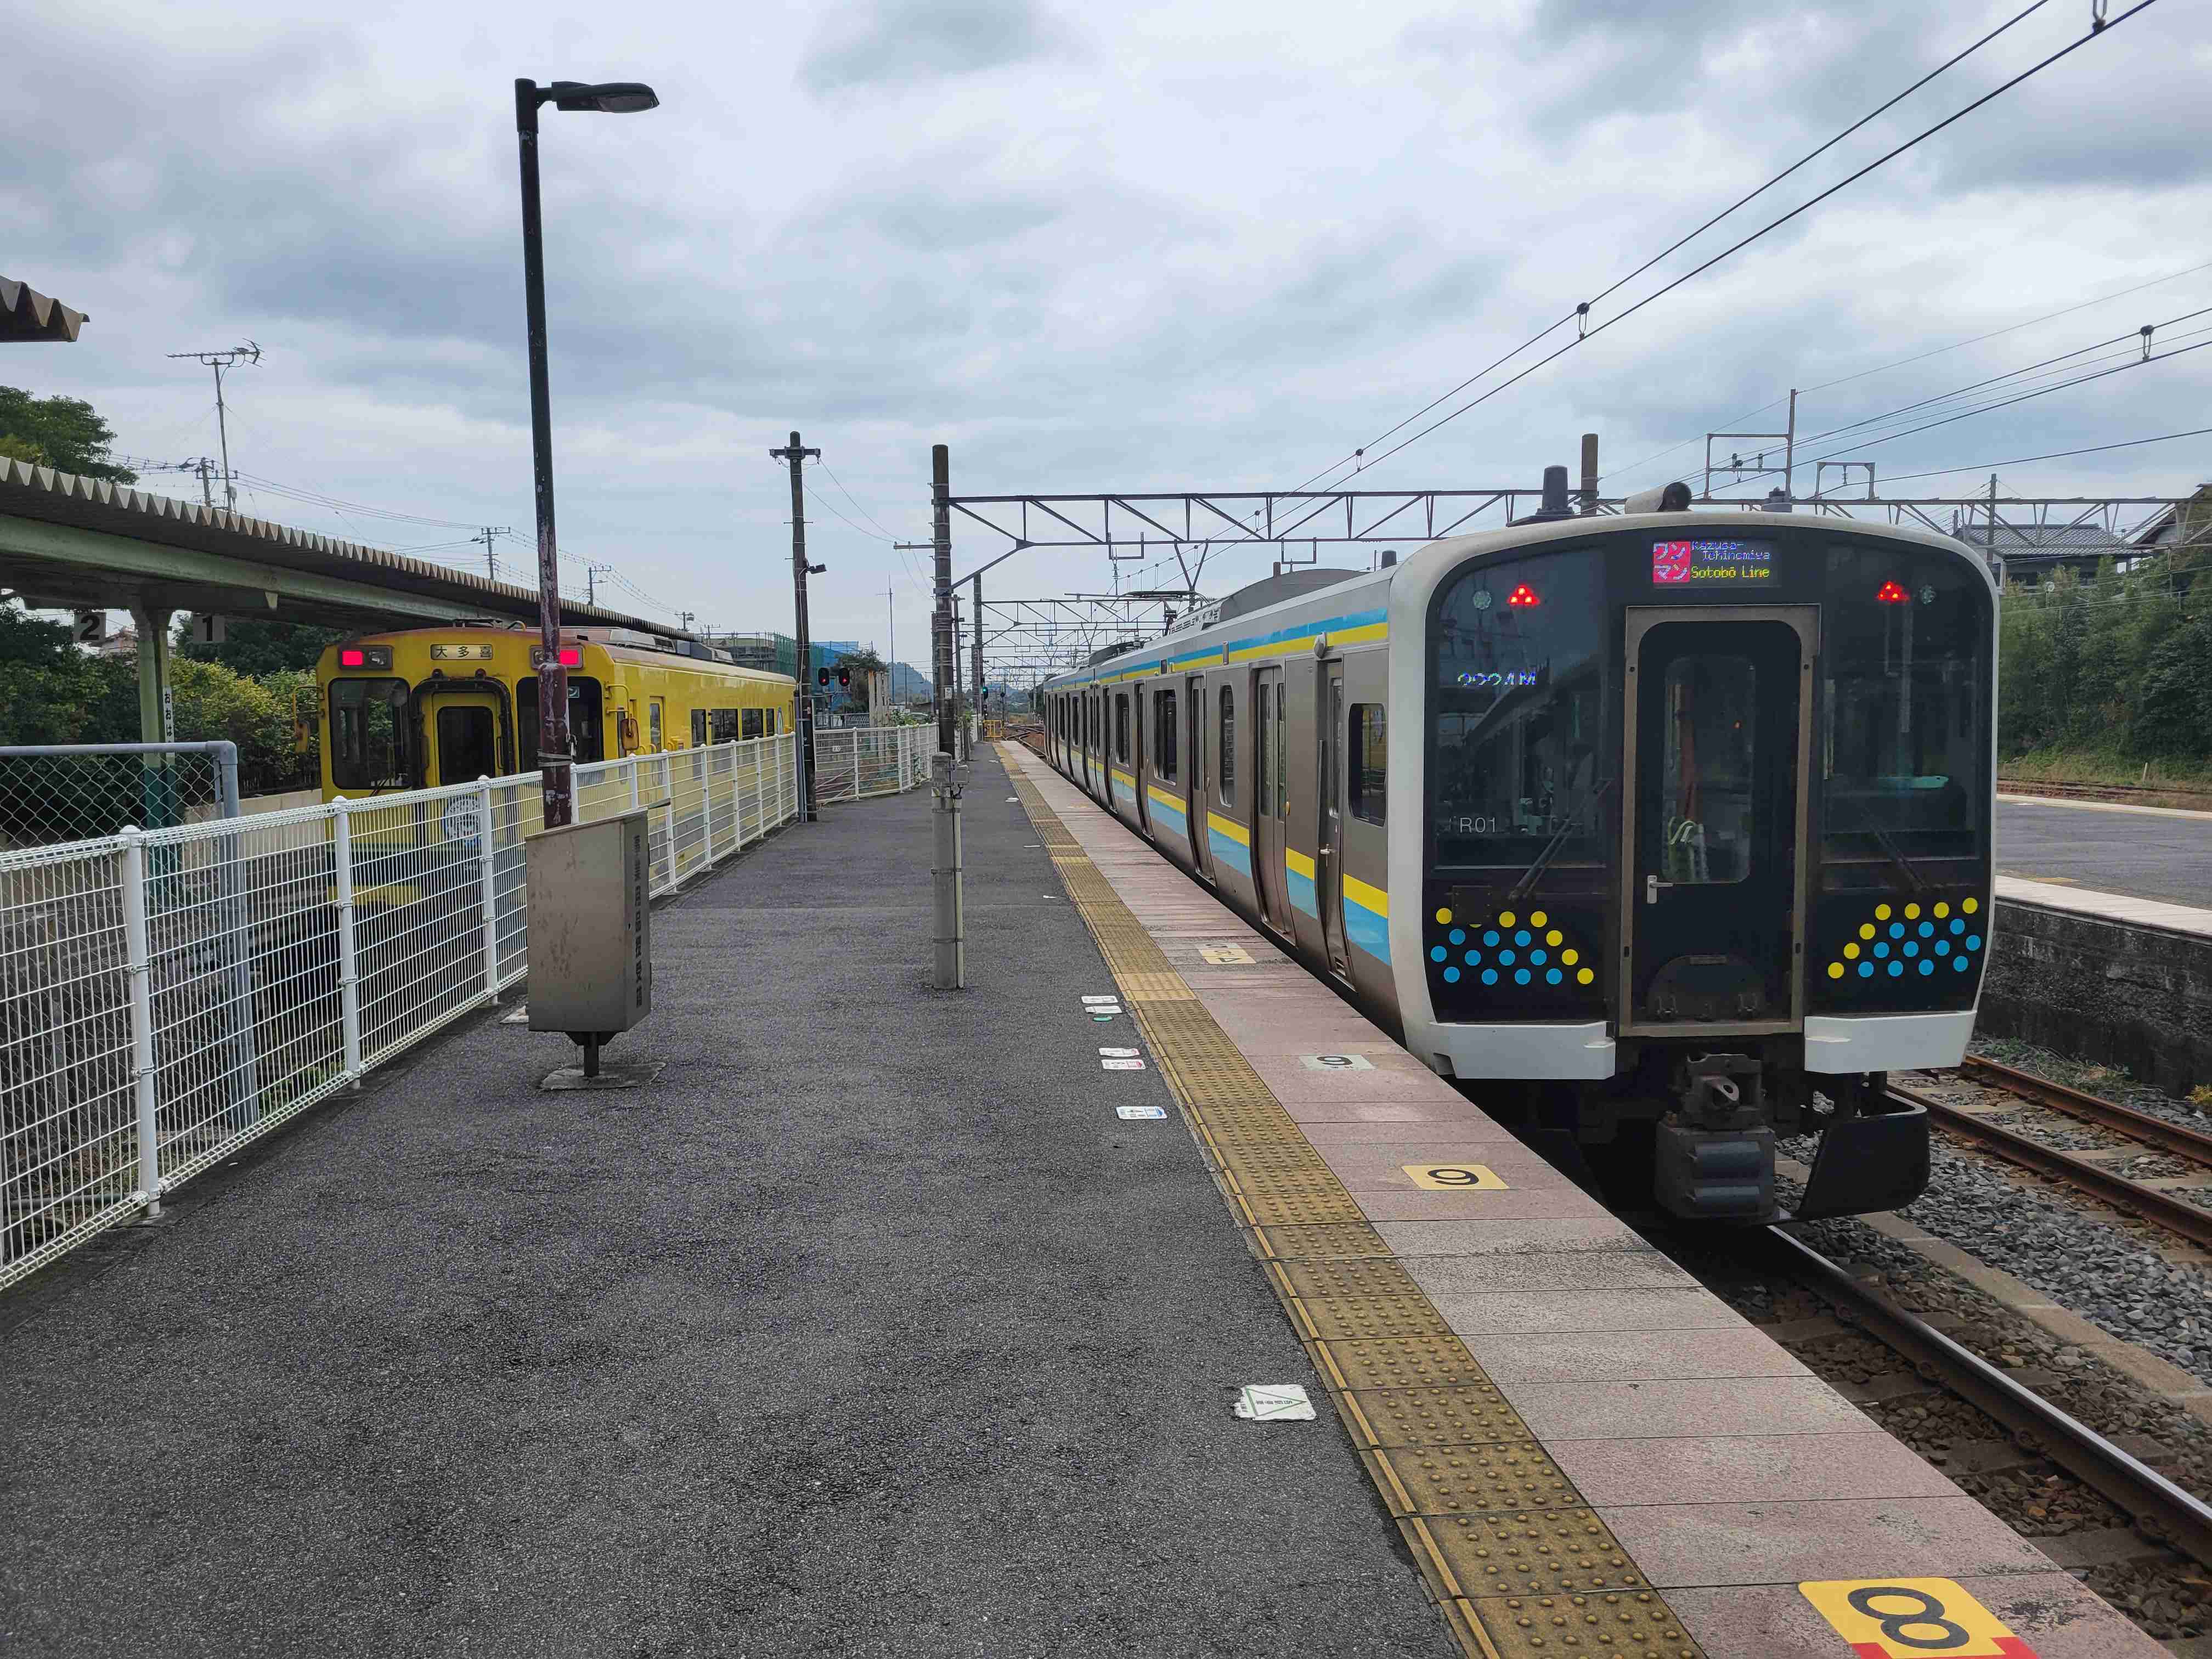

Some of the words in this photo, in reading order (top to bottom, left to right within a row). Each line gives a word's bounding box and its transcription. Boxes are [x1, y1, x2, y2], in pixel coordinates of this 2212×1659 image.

[1653, 543, 1686, 560] ワン
[1654, 563, 1688, 579] マン
[1742, 564, 1770, 578] Line
[80, 614, 100, 641] 2
[202, 616, 213, 641] 1
[435, 645, 492, 658] 大多喜
[1459, 817, 1496, 833] R01
[1847, 1587, 1970, 1650] 8
